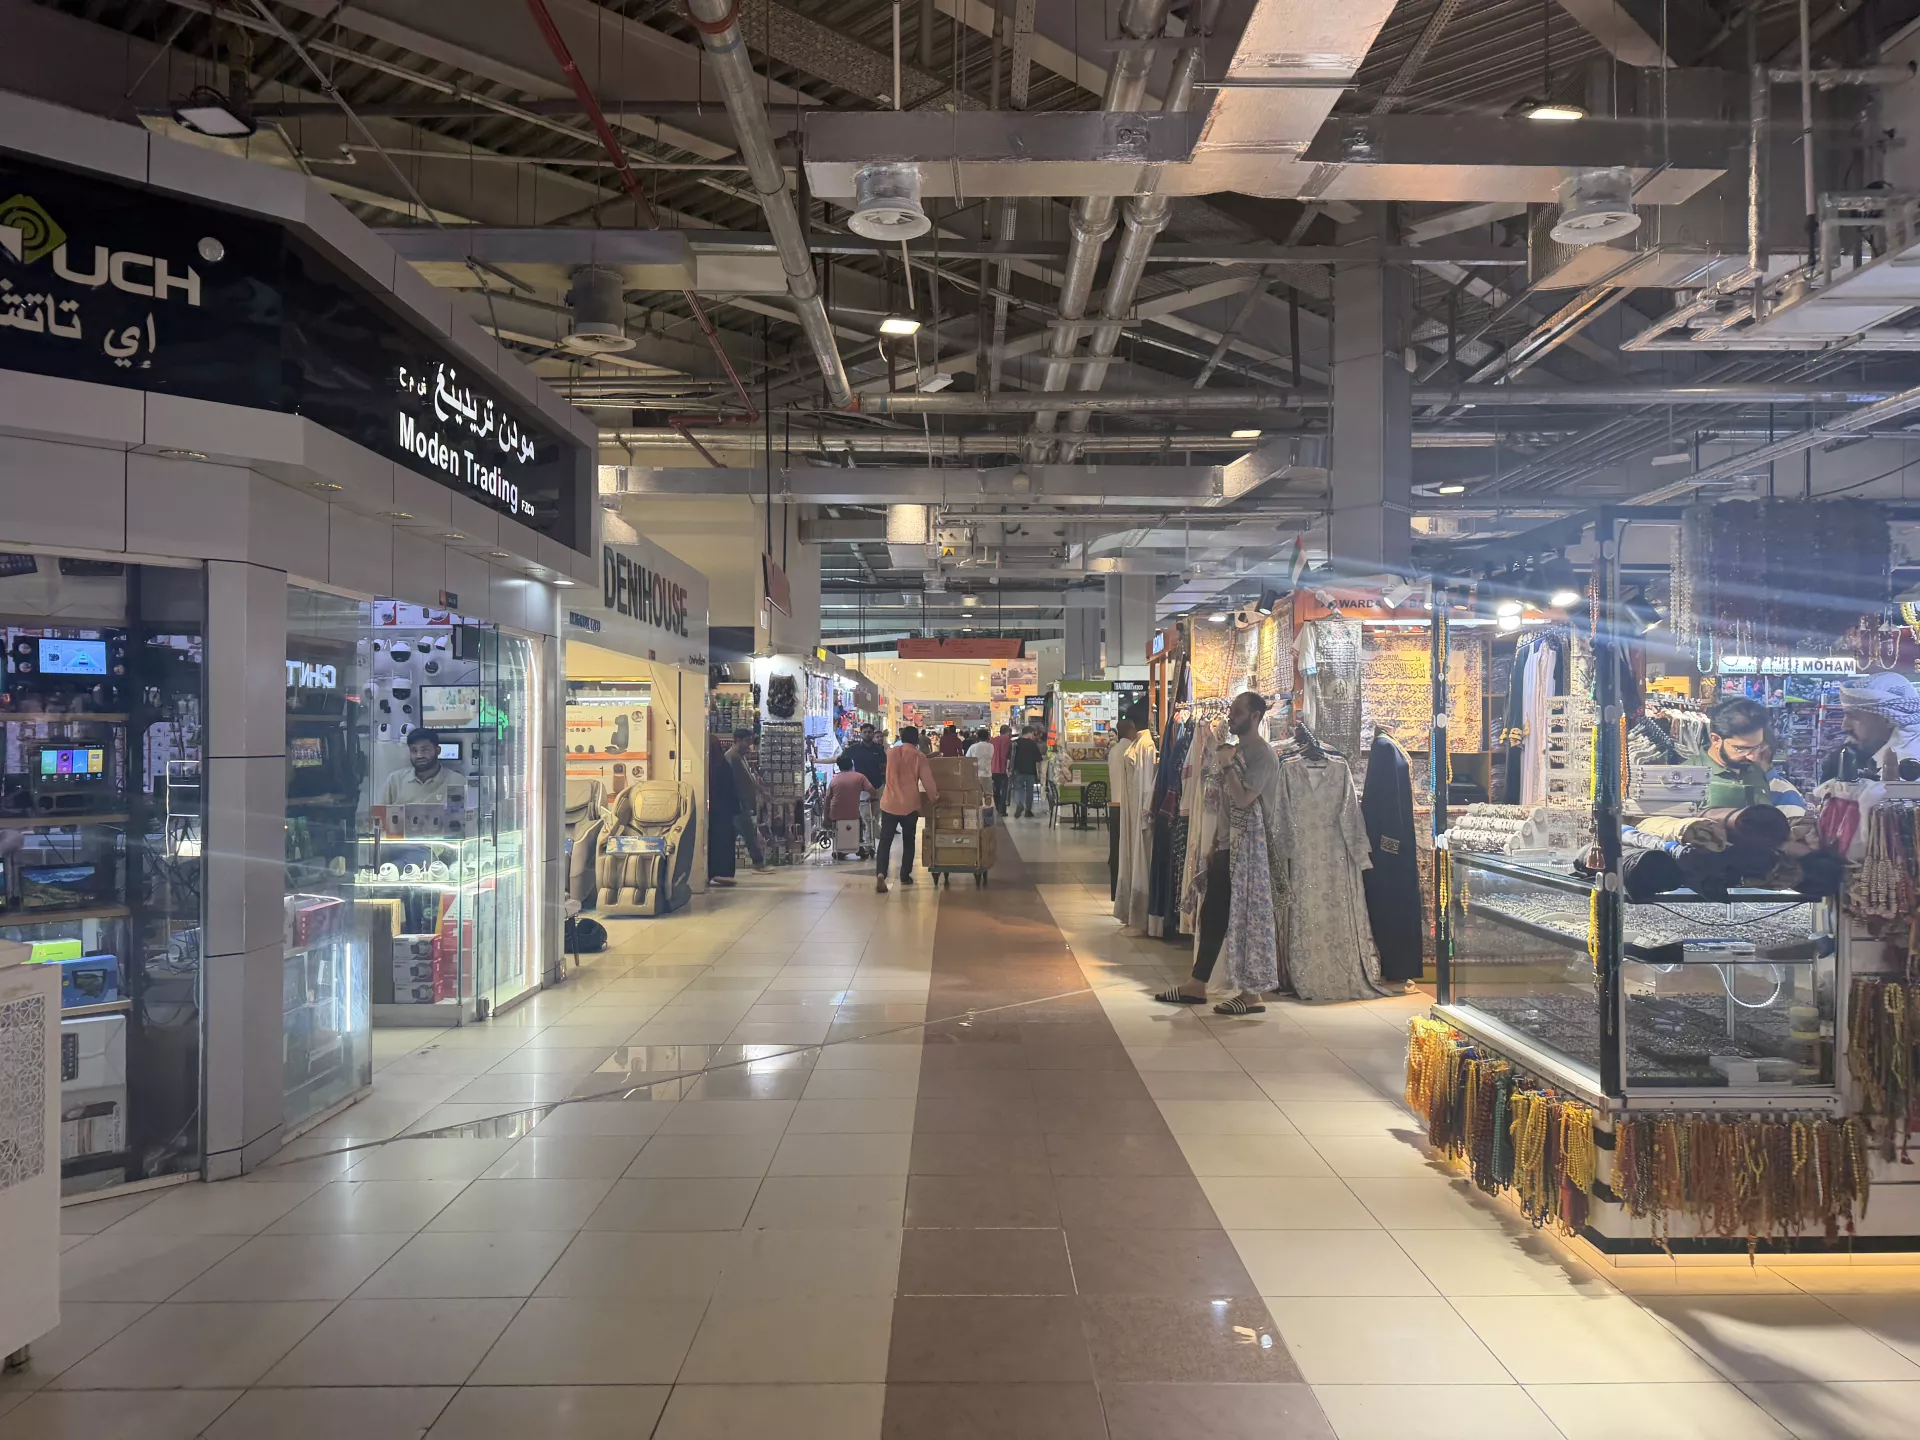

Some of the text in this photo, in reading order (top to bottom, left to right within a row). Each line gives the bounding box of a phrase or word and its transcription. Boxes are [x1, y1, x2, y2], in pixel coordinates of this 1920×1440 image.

[400, 411, 535, 517] Moden Trading FZCO
[603, 544, 689, 638] DENIHOUSE
